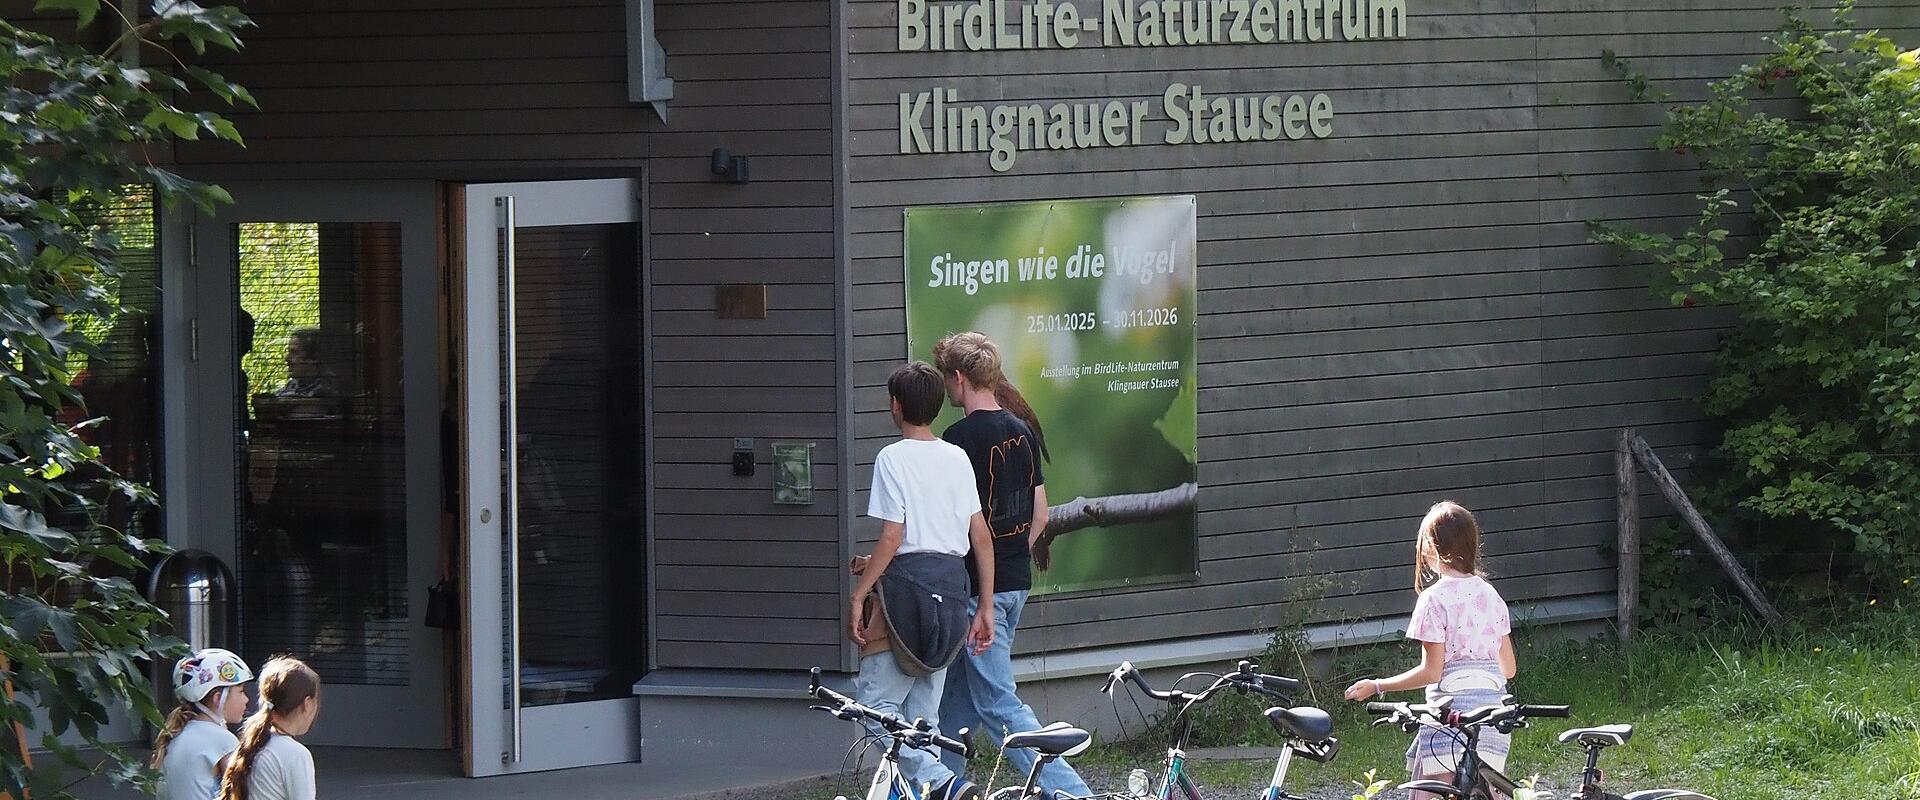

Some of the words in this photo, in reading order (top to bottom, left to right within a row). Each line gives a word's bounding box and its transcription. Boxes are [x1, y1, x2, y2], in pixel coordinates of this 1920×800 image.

[898, 0, 1407, 51] BirdLife-Naturzentrum
[899, 87, 1148, 171] Klingnauer
[1163, 83, 1334, 145] Stausee
[928, 252, 1009, 295] Singen
[1018, 247, 1058, 281] wie
[1066, 245, 1105, 279] die
[1027, 312, 1095, 333] 25.01.2025
[1114, 307, 1178, 328] 30.11.2026
[1040, 364, 1080, 379] Ausstellung
[1082, 363, 1092, 375] im
[1094, 360, 1179, 374] BirdLife-Naturzentrum
[1107, 379, 1149, 393] Klingnauer
[1151, 377, 1179, 389] Stausee
